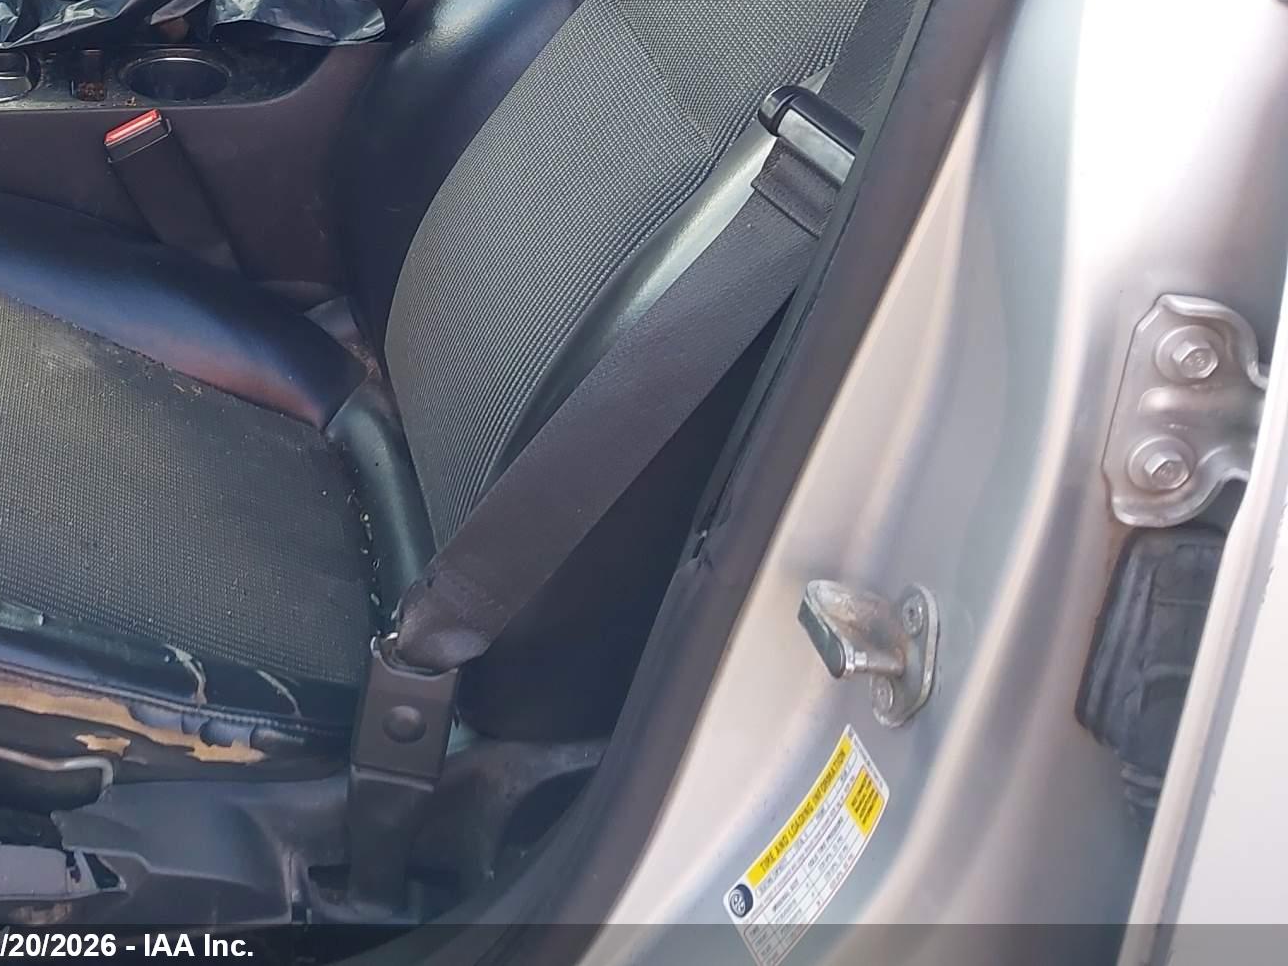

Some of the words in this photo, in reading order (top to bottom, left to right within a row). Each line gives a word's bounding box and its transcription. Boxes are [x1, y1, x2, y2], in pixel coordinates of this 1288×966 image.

[774, 832, 789, 857] AND
[786, 798, 814, 841] LOADING
[810, 748, 848, 805] INFORMATION
